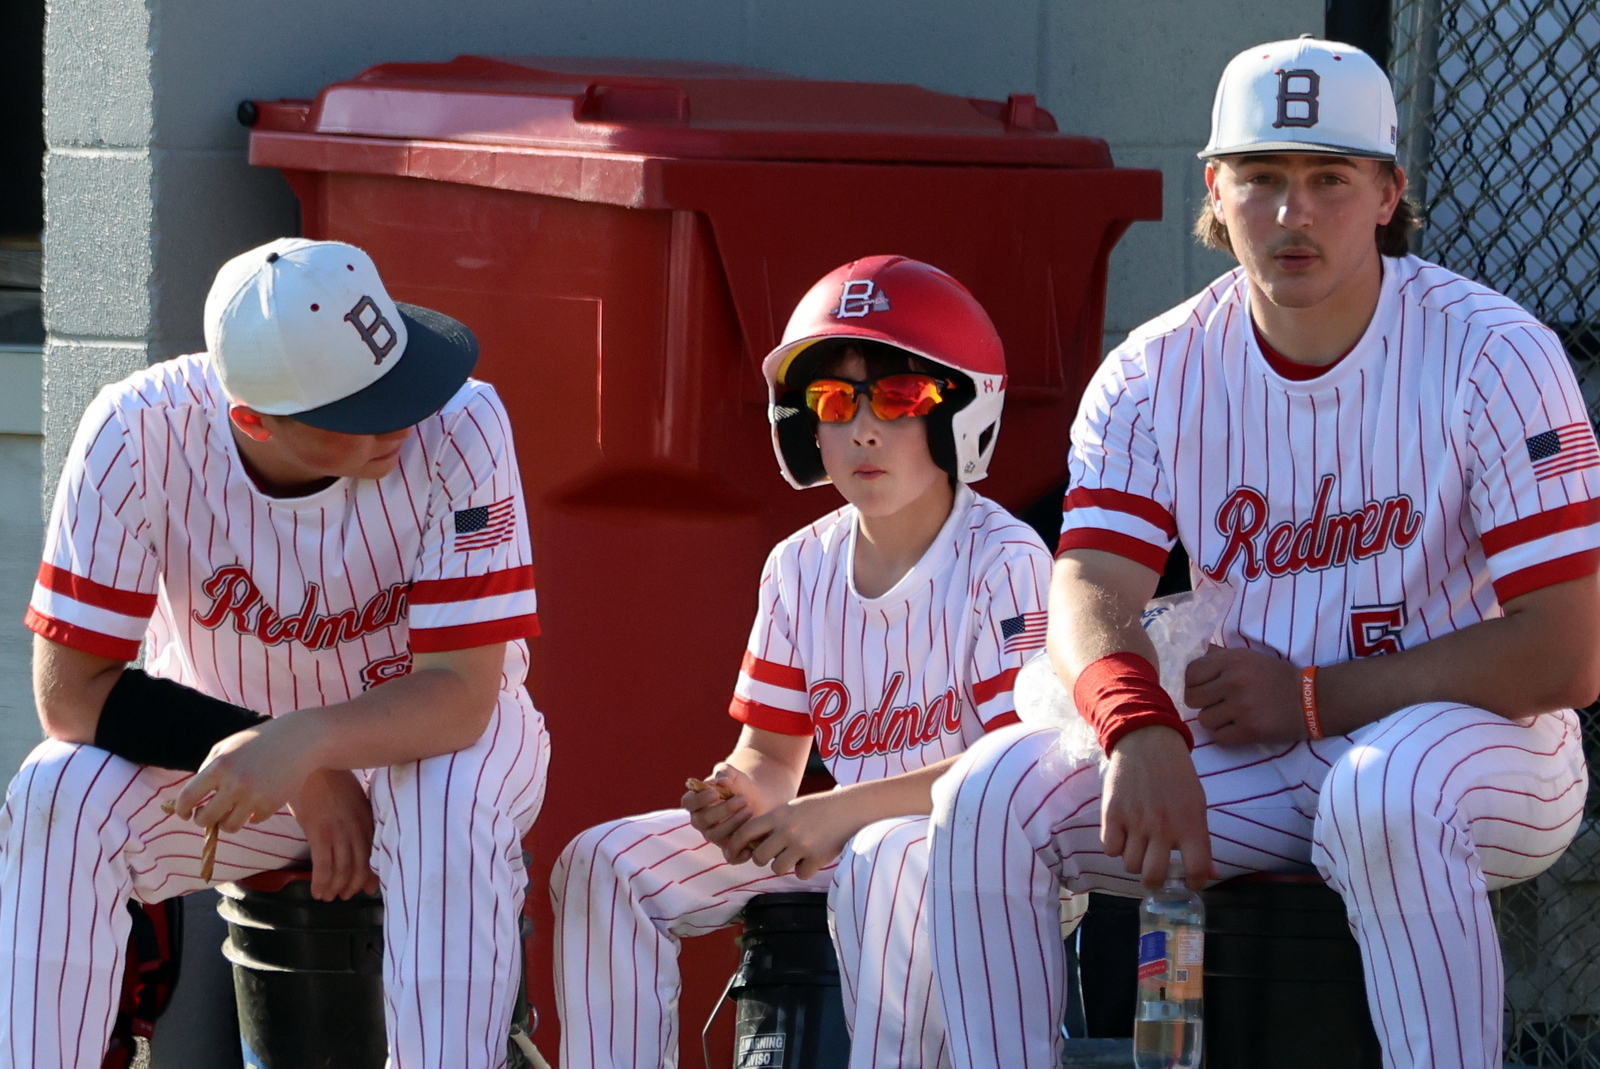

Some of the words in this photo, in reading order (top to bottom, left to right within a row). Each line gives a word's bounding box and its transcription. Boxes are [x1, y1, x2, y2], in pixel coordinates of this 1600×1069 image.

[1272, 69, 1321, 129] B
[836, 279, 875, 319] B
[344, 295, 398, 365] B
[1203, 474, 1423, 583] Redmen
[1304, 683, 1313, 709] NOAH
[744, 1036, 784, 1050] WARNING
